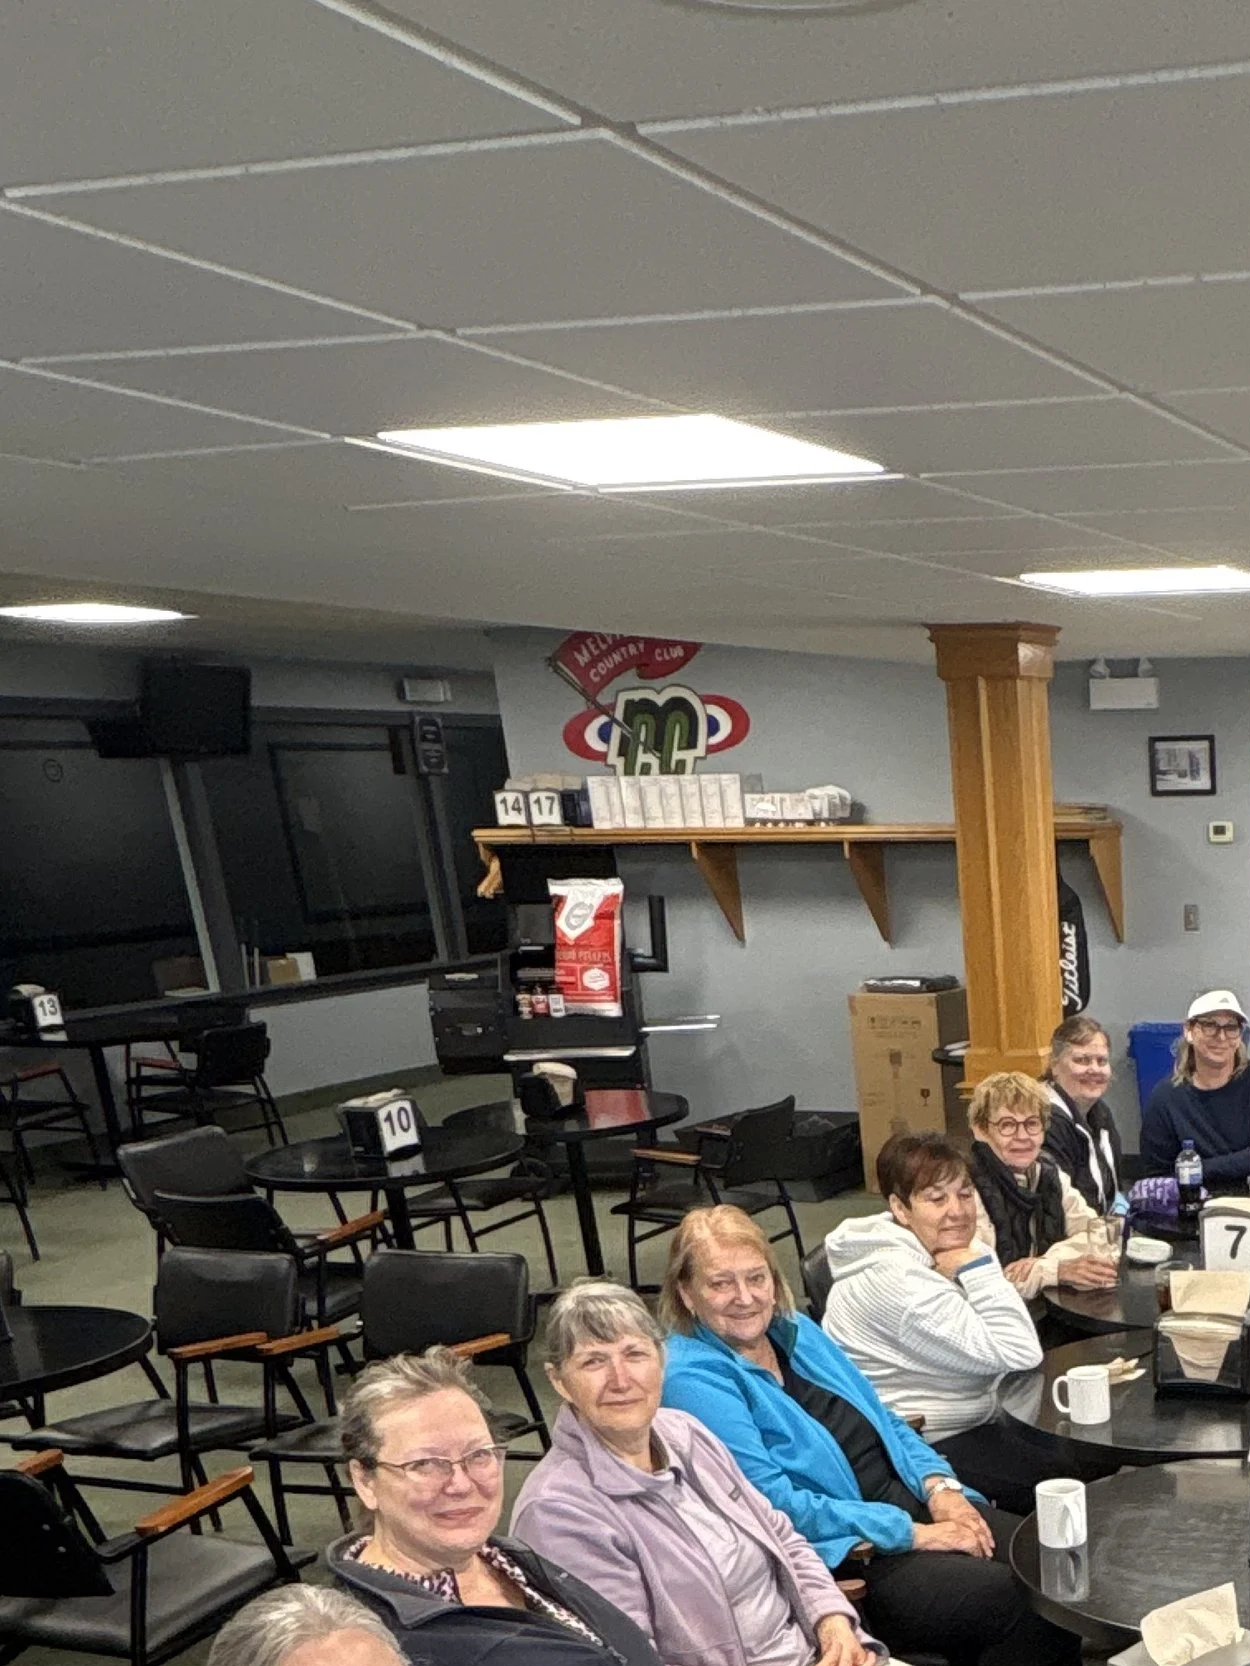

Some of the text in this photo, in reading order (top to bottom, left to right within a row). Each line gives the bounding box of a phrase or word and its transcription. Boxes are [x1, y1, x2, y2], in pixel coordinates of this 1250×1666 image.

[589, 640, 685, 683] COUNTRY CLUB
[500, 796, 523, 817] 14
[533, 795, 556, 817] 17
[1059, 921, 1083, 1011] Titleist
[39, 997, 58, 1017] 13
[384, 1106, 412, 1137] 10
[1223, 1224, 1248, 1260] 7
